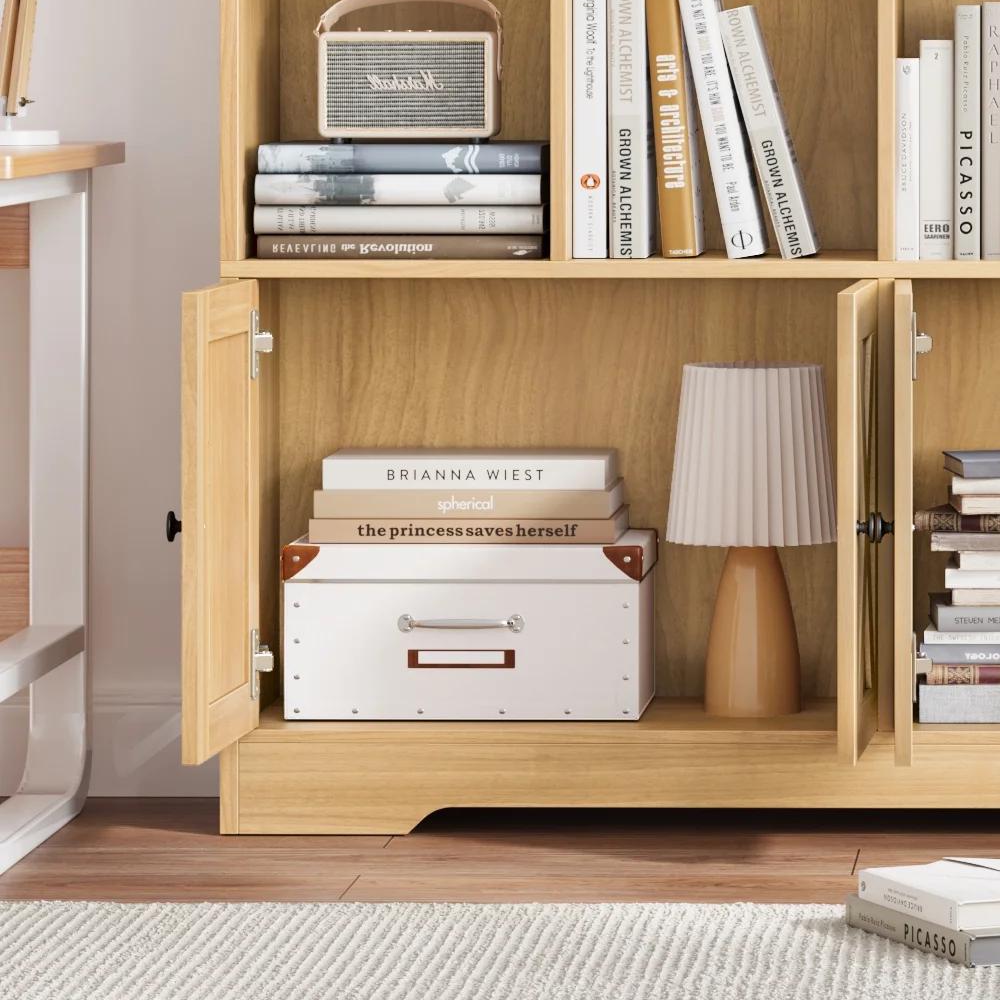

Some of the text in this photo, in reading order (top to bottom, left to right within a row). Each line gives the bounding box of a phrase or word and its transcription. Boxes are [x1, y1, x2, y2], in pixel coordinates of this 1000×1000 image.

[586, 22, 598, 45] Woolf
[586, 47, 595, 55] To
[586, 55, 595, 66] the
[619, 29, 633, 103] ALCHEMIST
[726, 9, 767, 117] ROWN ALCHEMIST
[584, 66, 595, 100] Lighthouse
[989, 25, 999, 144] RAPHAEL
[656, 53, 686, 189] arts & architecture
[619, 128, 633, 258] GROWN ALCHEMIS
[761, 138, 784, 188] GROWN
[775, 191, 803, 257] ALCHEMIS
[959, 131, 973, 235] PICASSO
[924, 224, 950, 233] EERO
[387, 469, 545, 481] BRIANNA WIEST
[437, 496, 494, 514] spherical
[357, 523, 579, 541] the princess saves herself
[954, 617, 984, 625] STEVEN
[903, 923, 957, 957] PICASSO
